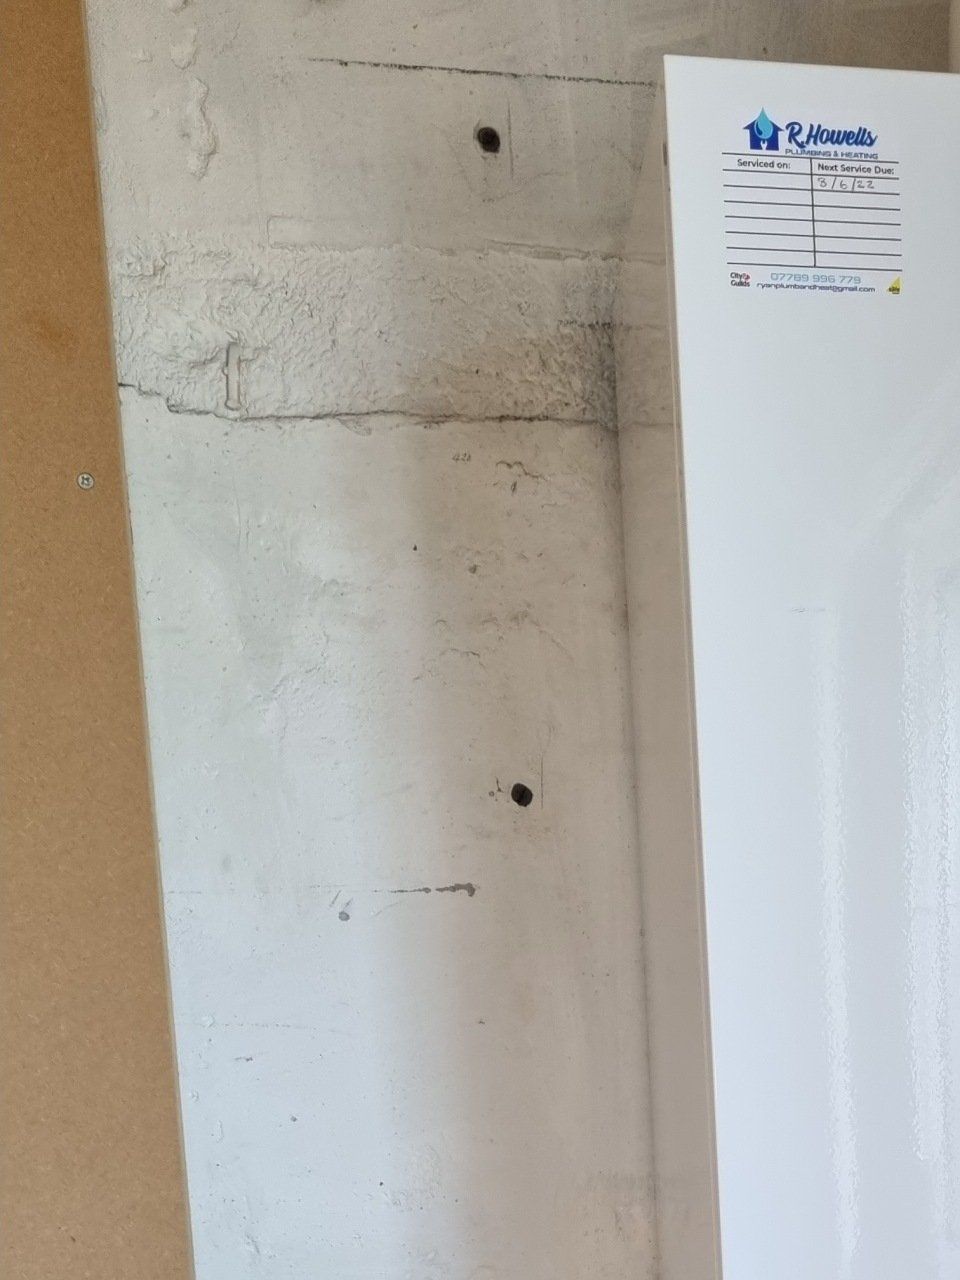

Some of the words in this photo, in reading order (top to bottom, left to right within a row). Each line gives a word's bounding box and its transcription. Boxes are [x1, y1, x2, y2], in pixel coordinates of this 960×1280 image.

[785, 121, 878, 149] R.Howells
[785, 149, 831, 158] PLUMBING
[841, 151, 879, 160] HEATING
[737, 159, 775, 169] Serviced
[777, 161, 791, 170] on:
[818, 163, 839, 172] Next
[841, 164, 872, 174] Service
[874, 165, 895, 175] Due:
[730, 272, 743, 281] City
[770, 272, 809, 282] 07789
[812, 274, 836, 283] 996
[839, 275, 862, 285] 779
[731, 279, 751, 288] Guilds
